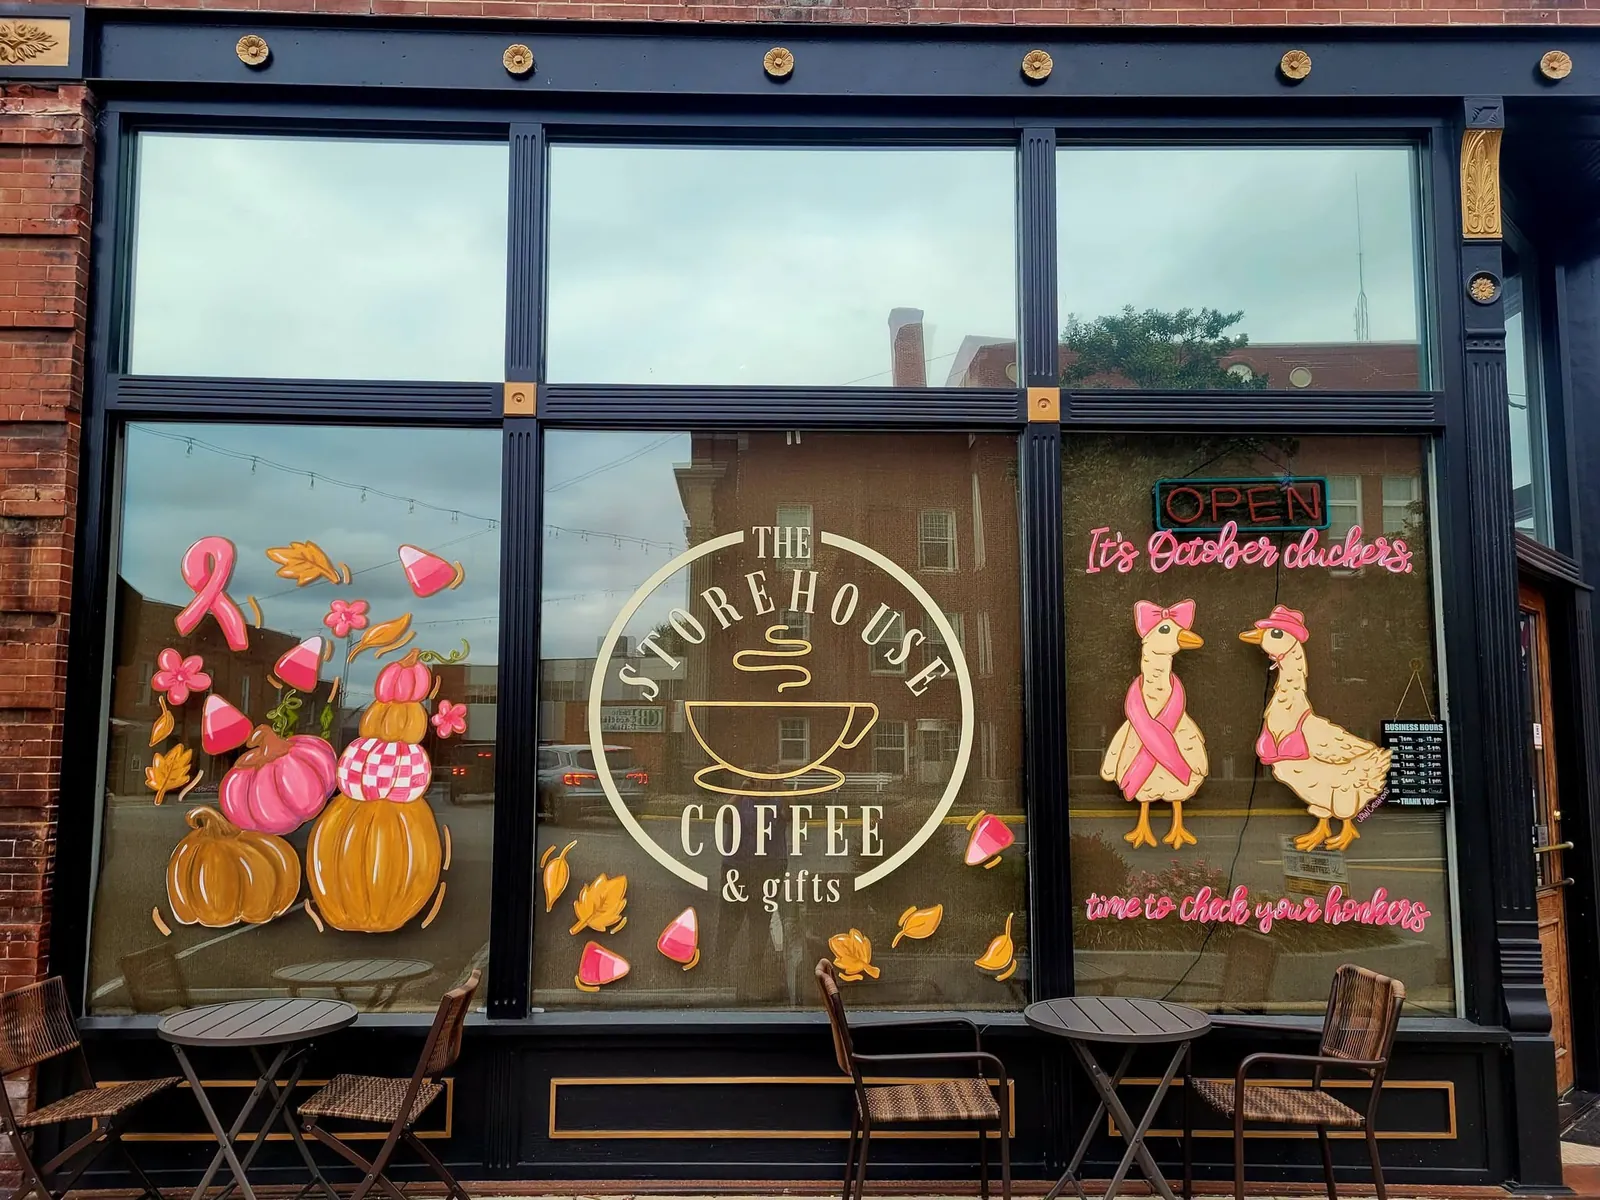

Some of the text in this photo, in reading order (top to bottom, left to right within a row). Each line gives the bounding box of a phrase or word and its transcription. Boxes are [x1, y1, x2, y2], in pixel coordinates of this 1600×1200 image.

[1166, 484, 1321, 524] OPEN
[752, 526, 811, 559] THE
[1085, 526, 1140, 574] It's
[1147, 520, 1280, 574] October
[618, 569, 951, 702] STOREHOUSE
[1384, 723, 1444, 732] BUSINESS HOURS
[1400, 797, 1435, 806] THANK YOU
[680, 804, 884, 857] COFFEE
[721, 869, 841, 913] & gifts
[1086, 893, 1143, 921] time
[1144, 892, 1177, 920] to
[1179, 885, 1251, 926] check
[1254, 897, 1323, 934] your
[1324, 885, 1432, 933] honkers
